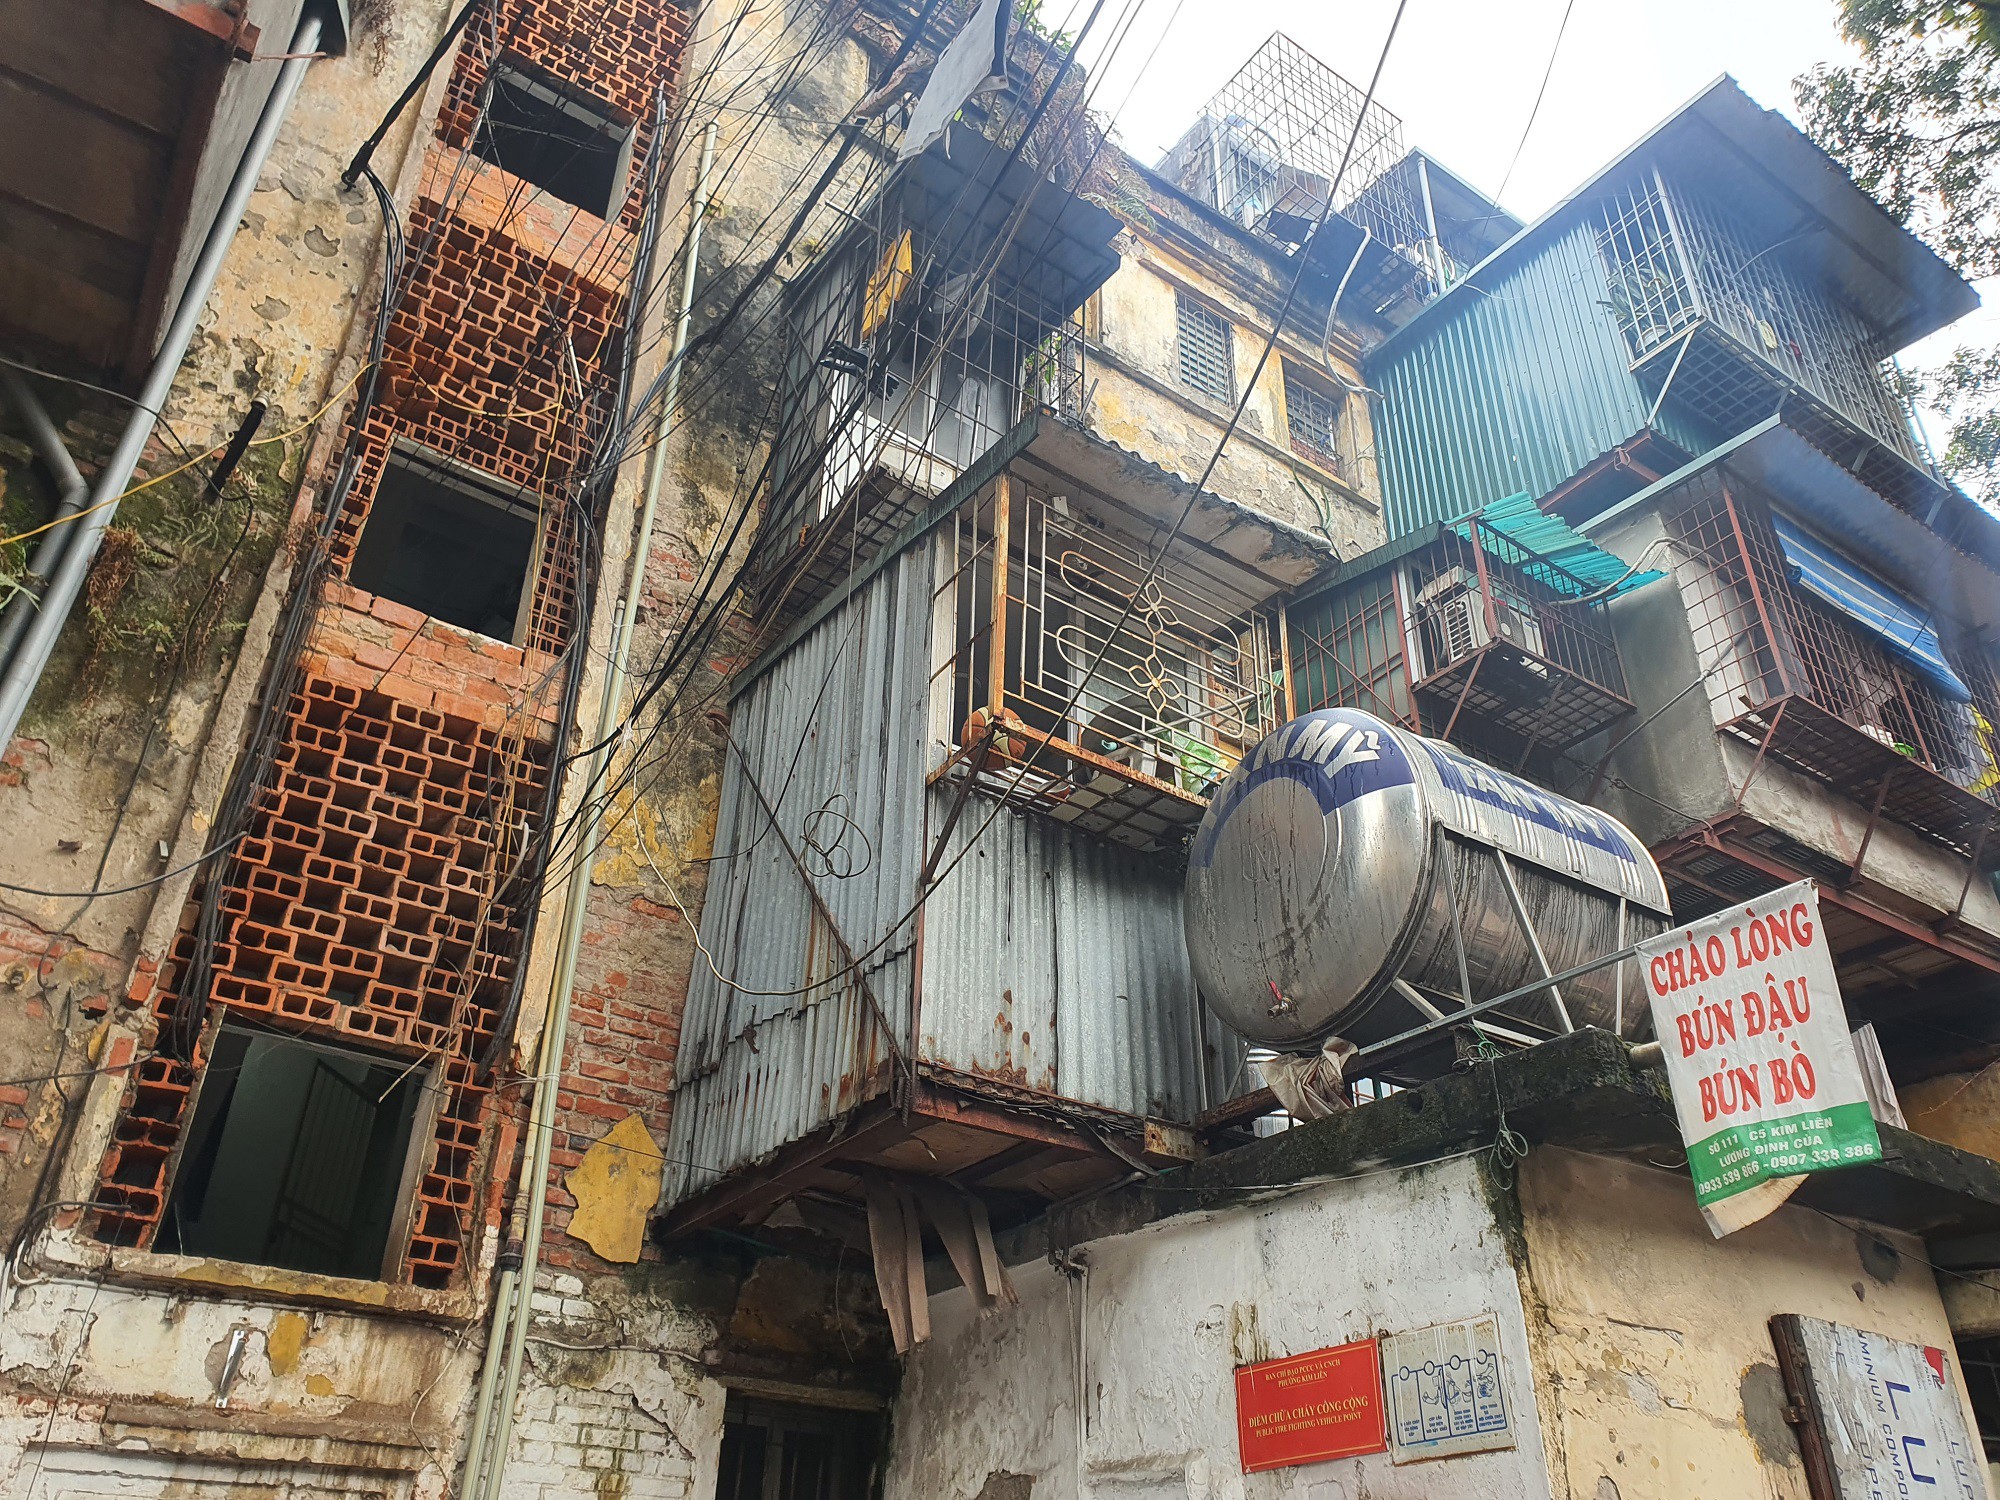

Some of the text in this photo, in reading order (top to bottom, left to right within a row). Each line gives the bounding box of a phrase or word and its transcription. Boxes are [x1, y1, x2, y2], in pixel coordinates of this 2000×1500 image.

[1730, 902, 1813, 969] LÒNG
[1676, 972, 1811, 1058] BÚN ĐẬU
[1699, 1040, 1816, 1122] BÚN BÒ
[1708, 1117, 1833, 1155] SỐ 111 C5 KIM LIÊN
[1719, 1134, 1823, 1168] LƯƠNG ĐỊNH CỦA
[1699, 1178, 1722, 1195] 0933
[1723, 1170, 1741, 1185] 539
[1742, 1161, 1760, 1177] 866
[1770, 1154, 1807, 1168] 0907
[1812, 1148, 1840, 1163] 338
[1845, 1143, 1874, 1158] 386
[1278, 1371, 1328, 1388] PHƯỜNG KIM LIÊN
[1315, 1361, 1324, 1371] VÀ
[1256, 1411, 1362, 1438] PUBLIC FIRE FIGHTING VEHICLE POINT
[1269, 1409, 1291, 1423] CHỮA
[1292, 1403, 1316, 1420] CHÁY
[1317, 1400, 1341, 1414] CÔNG
[1343, 1396, 1368, 1410] CỘNG
